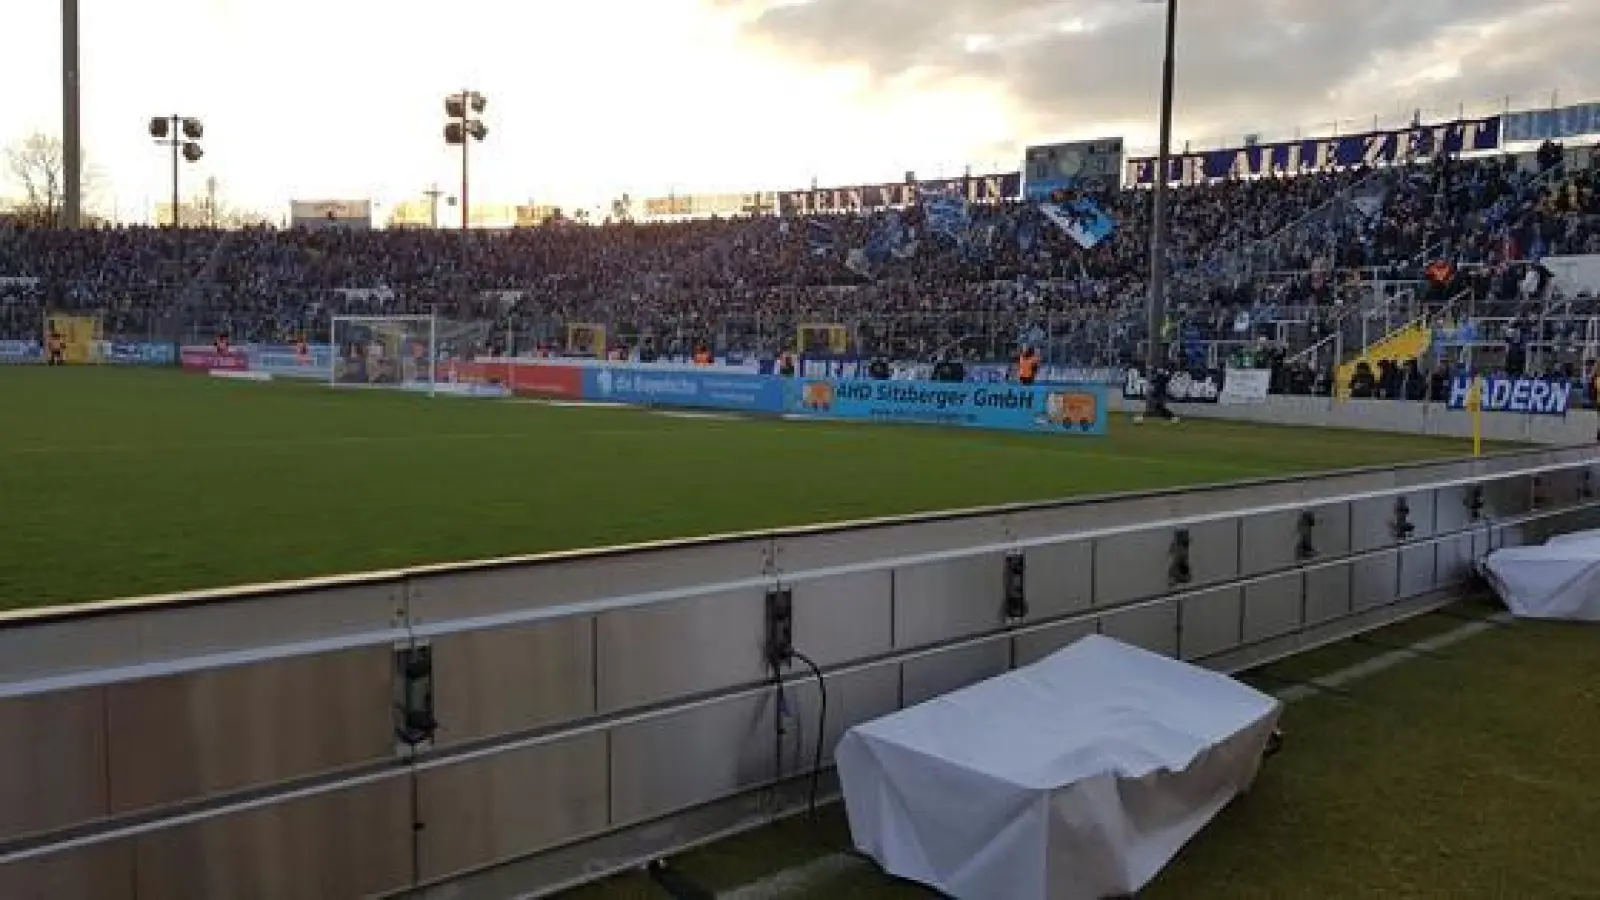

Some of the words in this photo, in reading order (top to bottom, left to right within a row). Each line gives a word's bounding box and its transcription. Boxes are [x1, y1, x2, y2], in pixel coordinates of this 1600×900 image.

[1228, 141, 1340, 181] ALLE
[1363, 121, 1487, 169] ZEIT
[876, 384, 967, 409] Sitzberger
[973, 388, 1034, 409] GmbH
